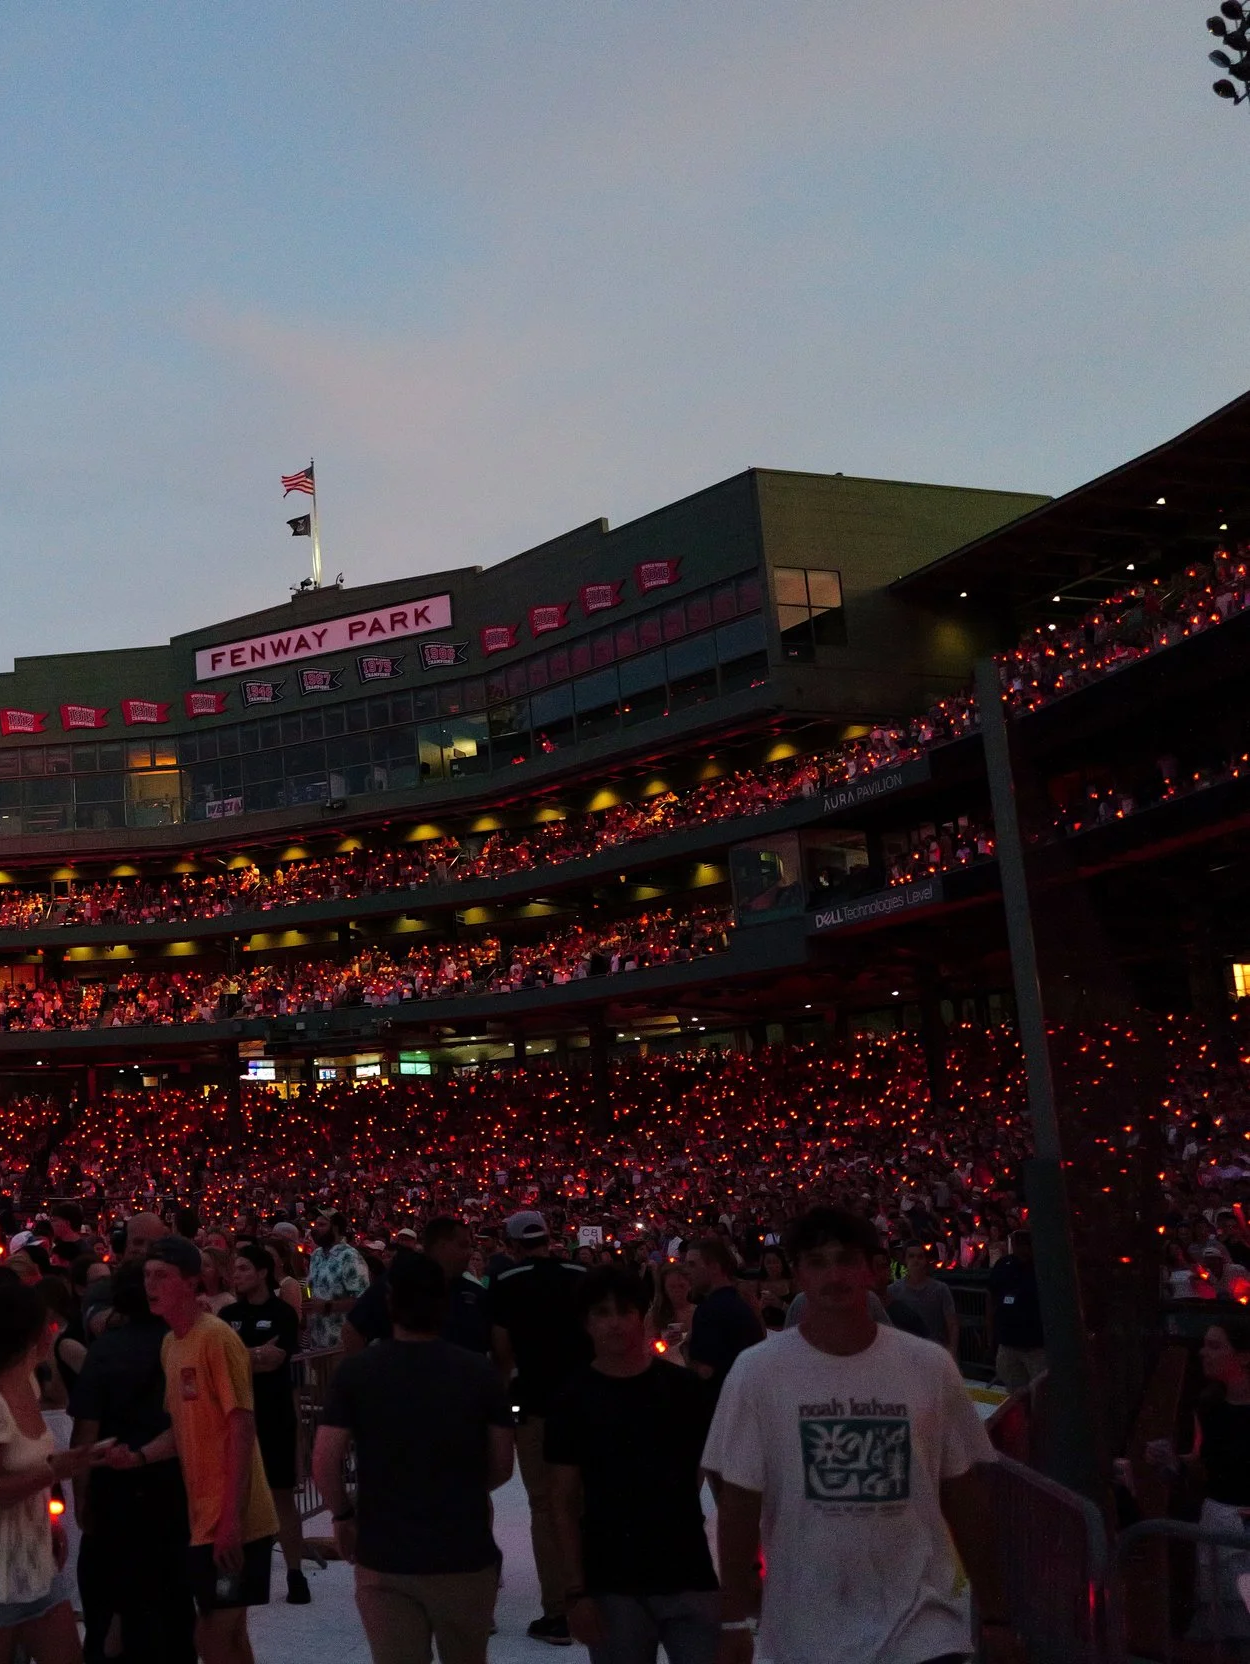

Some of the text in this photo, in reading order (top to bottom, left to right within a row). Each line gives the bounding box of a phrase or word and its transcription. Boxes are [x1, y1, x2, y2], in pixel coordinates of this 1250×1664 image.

[211, 605, 431, 670] FENWAY PARK
[424, 648, 455, 661] 1986
[363, 660, 392, 673] 1975
[856, 773, 903, 799] PAVILION
[906, 883, 933, 904] Level
[798, 1398, 908, 1416] noah kahan
